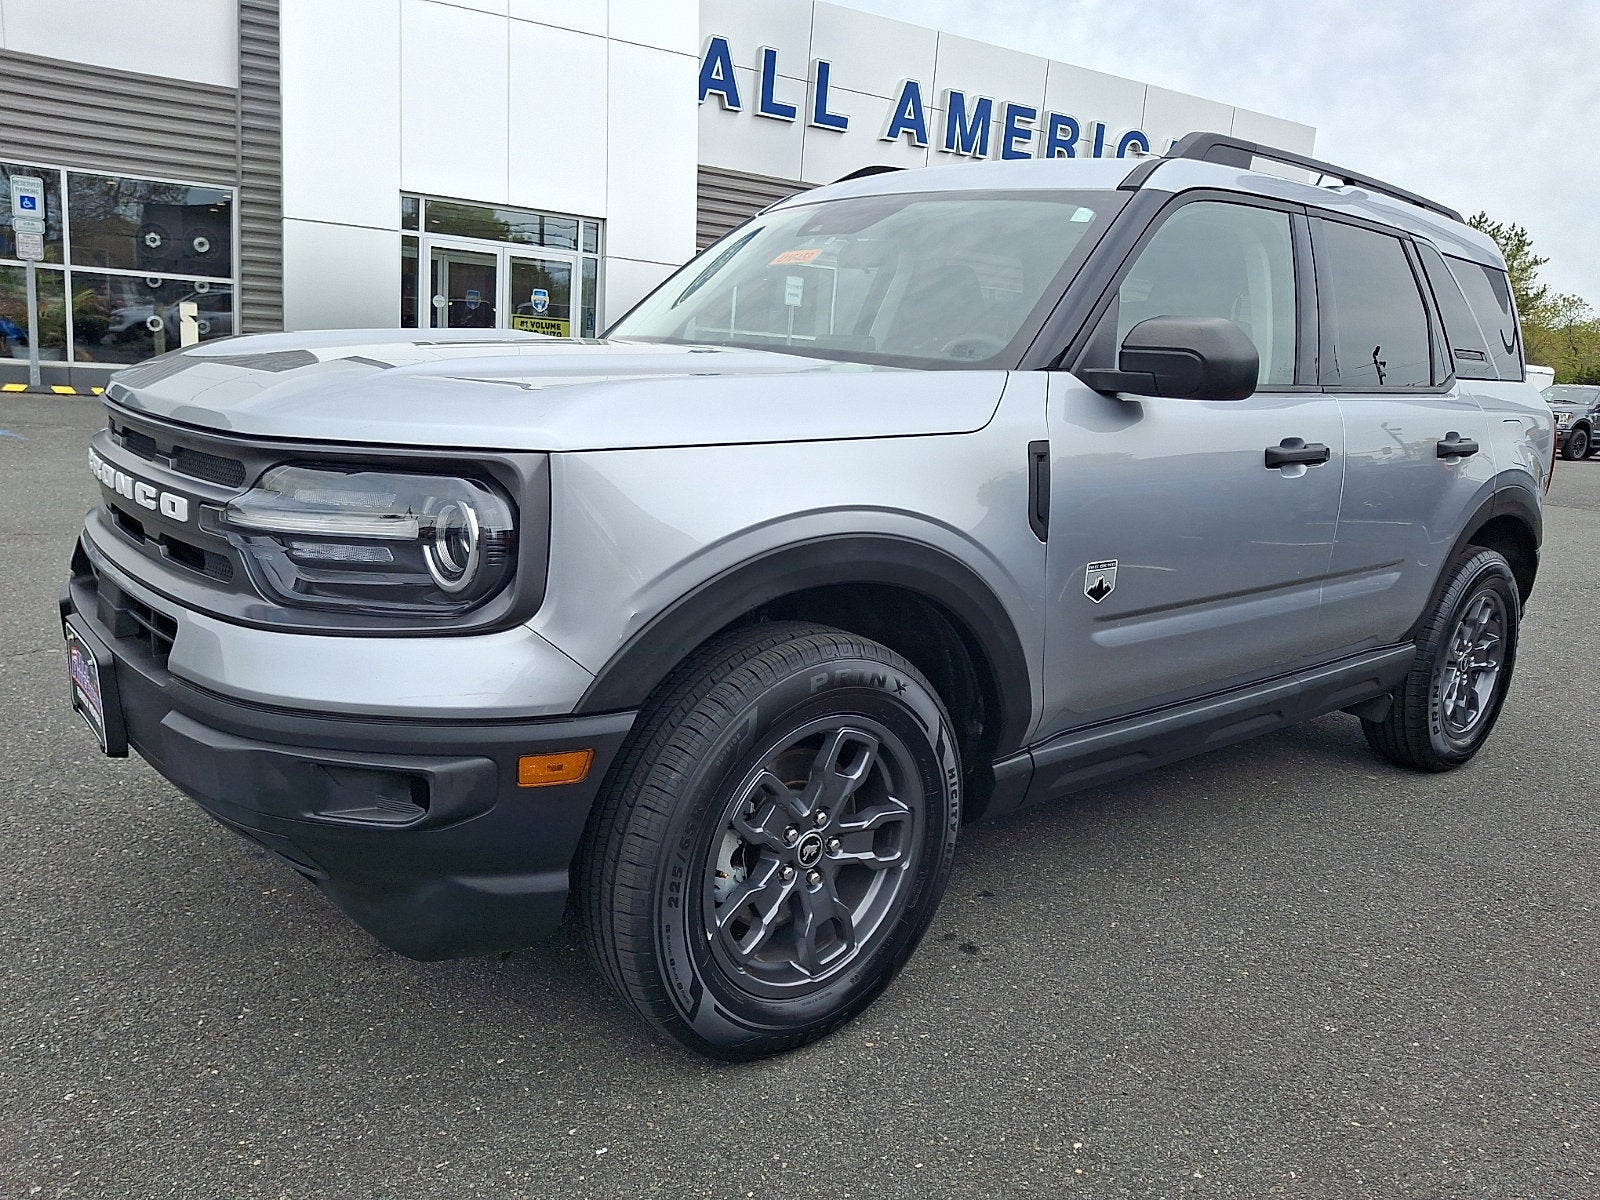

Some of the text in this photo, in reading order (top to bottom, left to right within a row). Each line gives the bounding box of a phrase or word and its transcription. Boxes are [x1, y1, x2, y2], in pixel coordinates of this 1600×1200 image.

[699, 35, 1179, 160] ALL AMERIC
[530, 321, 561, 330] VOLUME
[88, 447, 188, 522] BRONCO
[947, 767, 959, 833] HICITY
